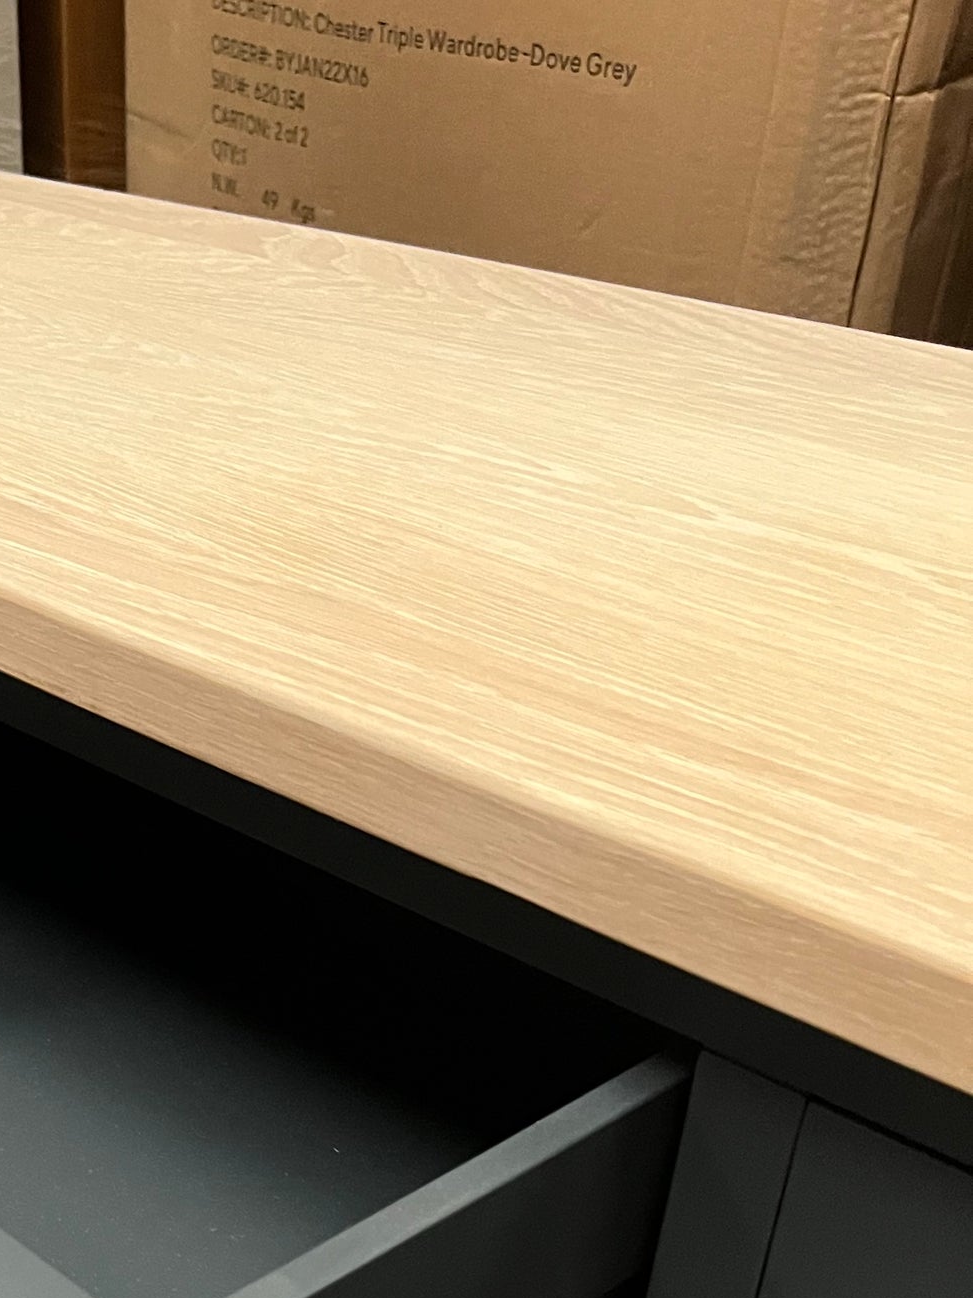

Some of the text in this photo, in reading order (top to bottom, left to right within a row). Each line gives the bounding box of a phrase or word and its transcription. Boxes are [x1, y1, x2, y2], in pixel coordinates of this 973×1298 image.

[314, 12, 375, 44] Chester
[377, 20, 425, 52] Triple
[586, 52, 637, 87] Grey
[274, 121, 283, 141] 2
[284, 125, 299, 144] of
[300, 126, 310, 148] 2
